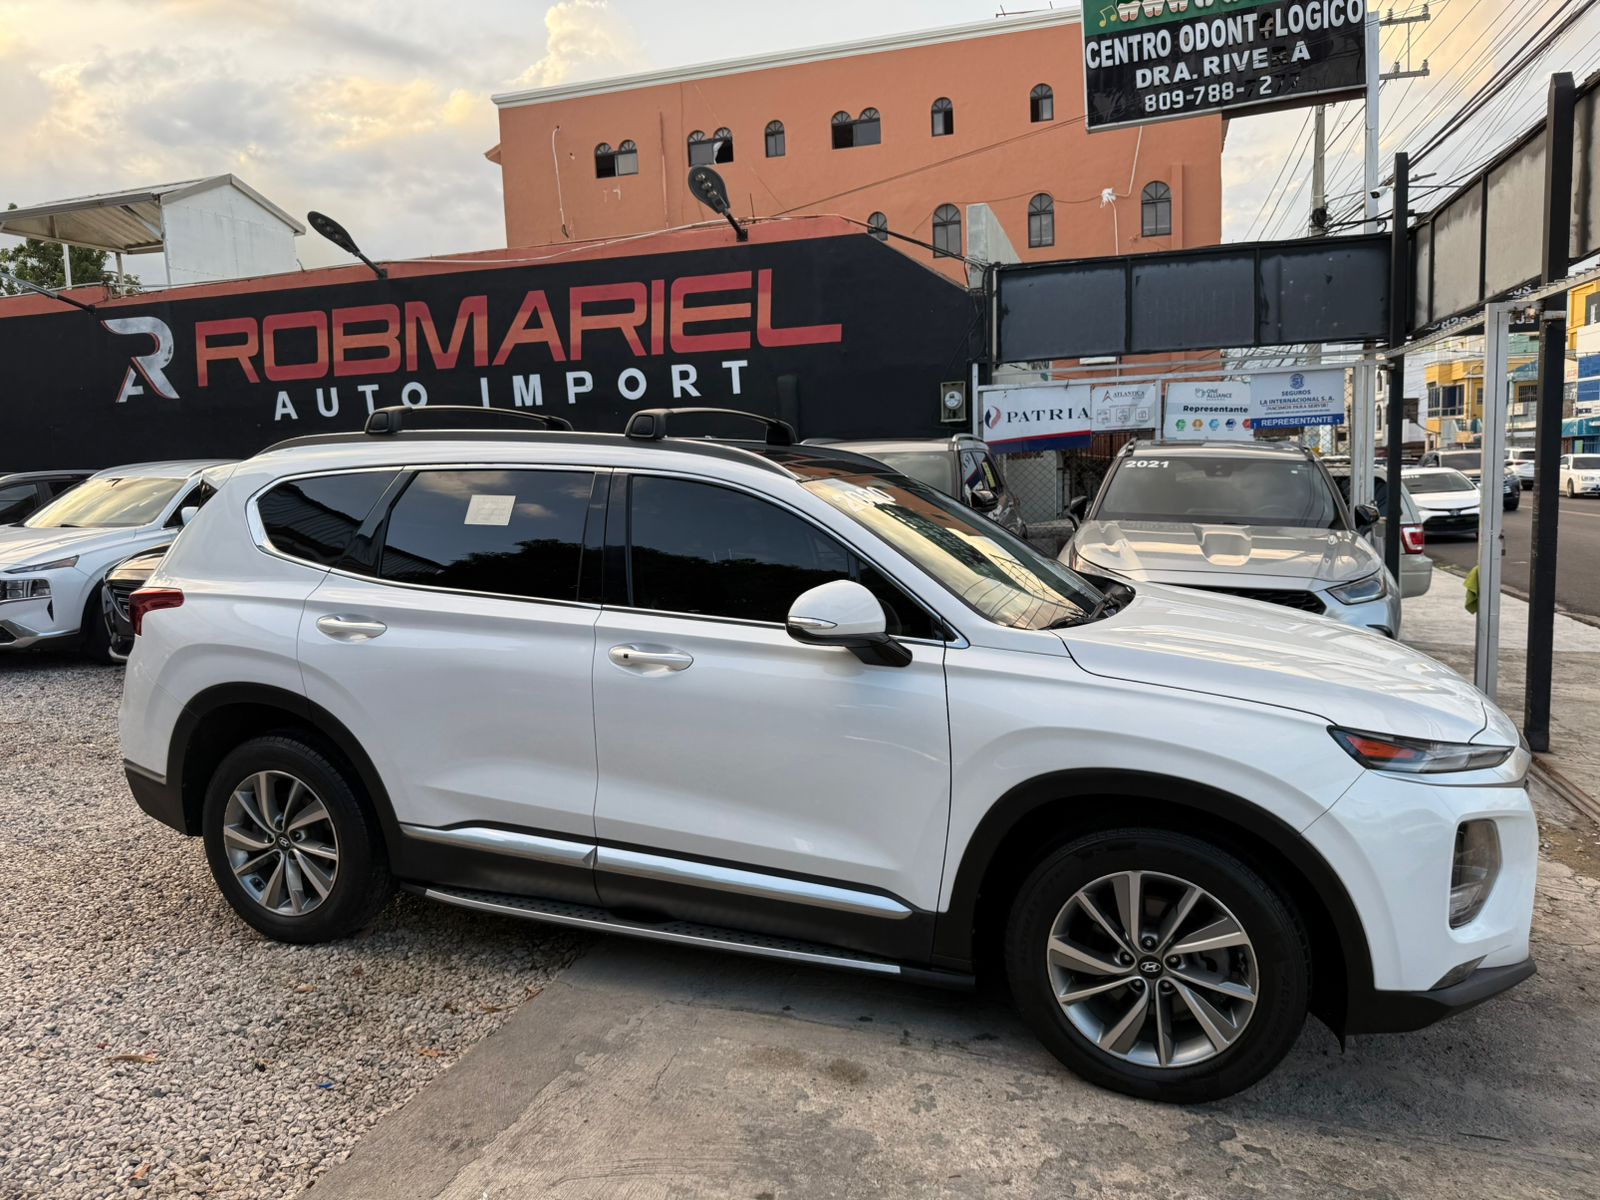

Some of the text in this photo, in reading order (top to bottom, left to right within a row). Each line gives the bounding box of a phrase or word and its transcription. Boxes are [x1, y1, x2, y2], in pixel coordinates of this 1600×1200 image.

[1085, 0, 1364, 69] CENTRO ODONTLOGICO
[1135, 40, 1311, 89] DRA. RIVEA
[195, 268, 842, 387] ROBMARIEL
[274, 359, 749, 421] AUTO IMPORT
[1281, 389, 1311, 397] SEGUROS
[1268, 396, 1320, 405] INTERNACIONAL
[1007, 406, 1090, 424] PATRIA
[1183, 405, 1249, 414] Representante
[1261, 416, 1333, 427] REPRESENTANTE
[1124, 459, 1170, 469] 2021
